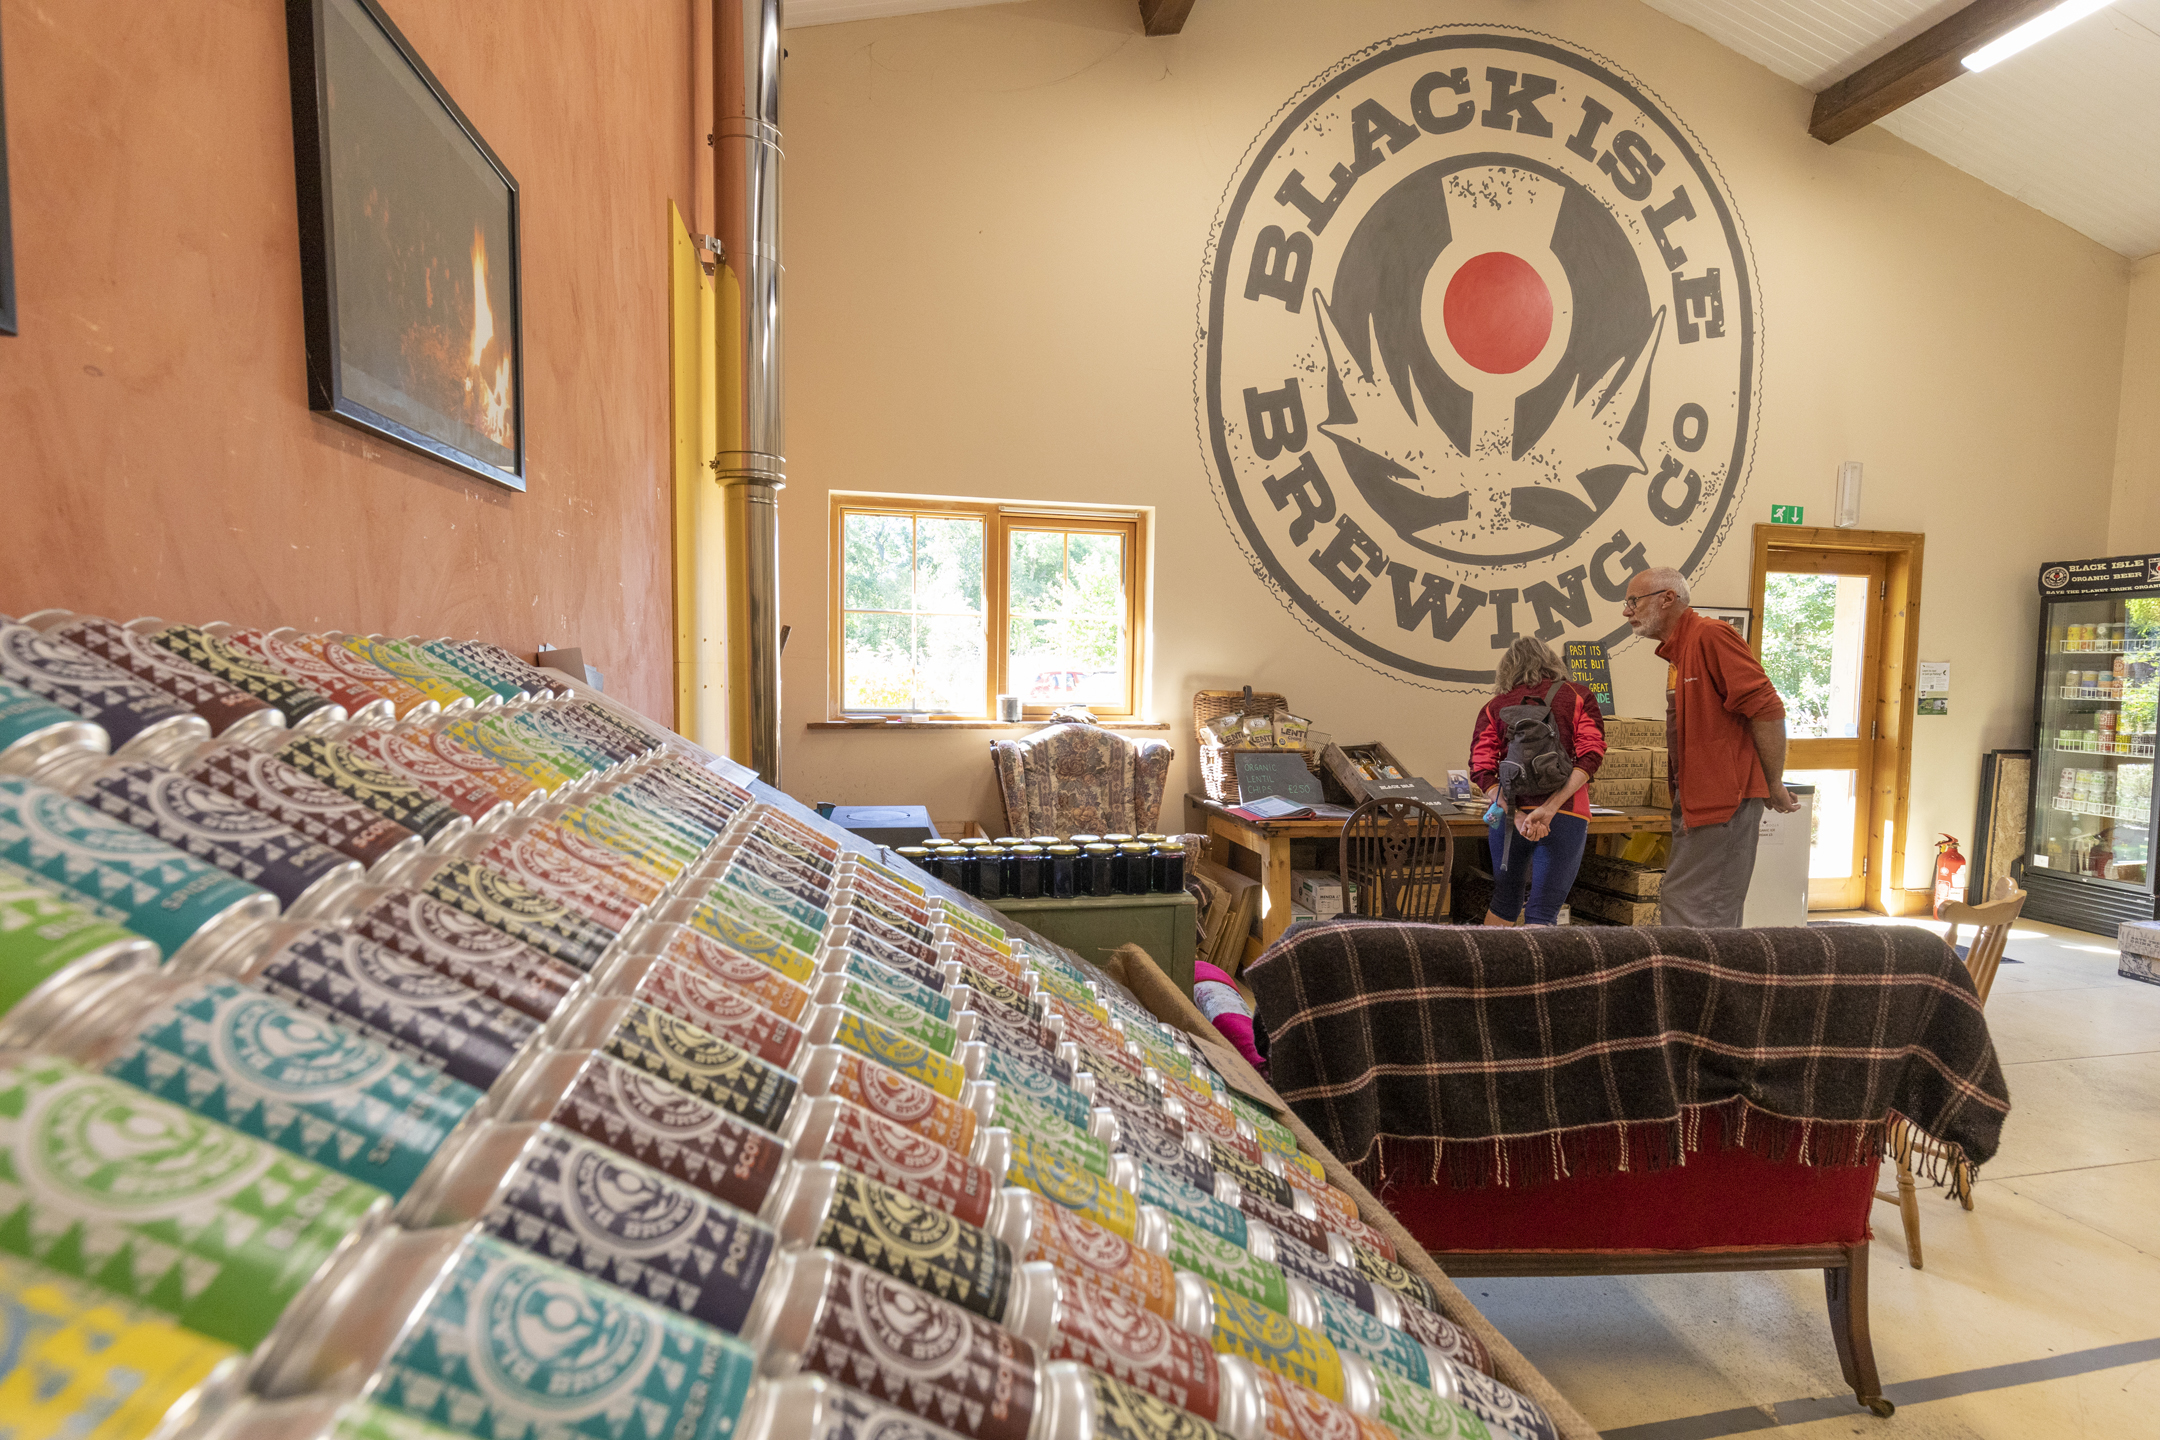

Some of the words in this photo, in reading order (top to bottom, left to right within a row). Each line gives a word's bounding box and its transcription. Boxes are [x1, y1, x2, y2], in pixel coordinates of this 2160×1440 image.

[1244, 66, 1557, 314] BLACK
[1564, 96, 1726, 345] ISLE
[1242, 377, 1650, 650] BREWING
[1646, 403, 1709, 527] CO
[2069, 563, 2107, 572] BLACK
[2111, 560, 2144, 569] ISLE
[2113, 572, 2142, 580] BEER
[1569, 645, 1587, 656] PAST
[1590, 645, 1602, 656] ITS
[1571, 659, 1588, 669] DATE
[1591, 659, 1605, 669] BUT
[1572, 672, 1594, 682] STILL
[1589, 683, 1609, 693] GREAT
[1244, 763, 1277, 772] ORGANIC
[1246, 775, 1275, 783] LENTIL
[1248, 785, 1273, 794] CHIPS
